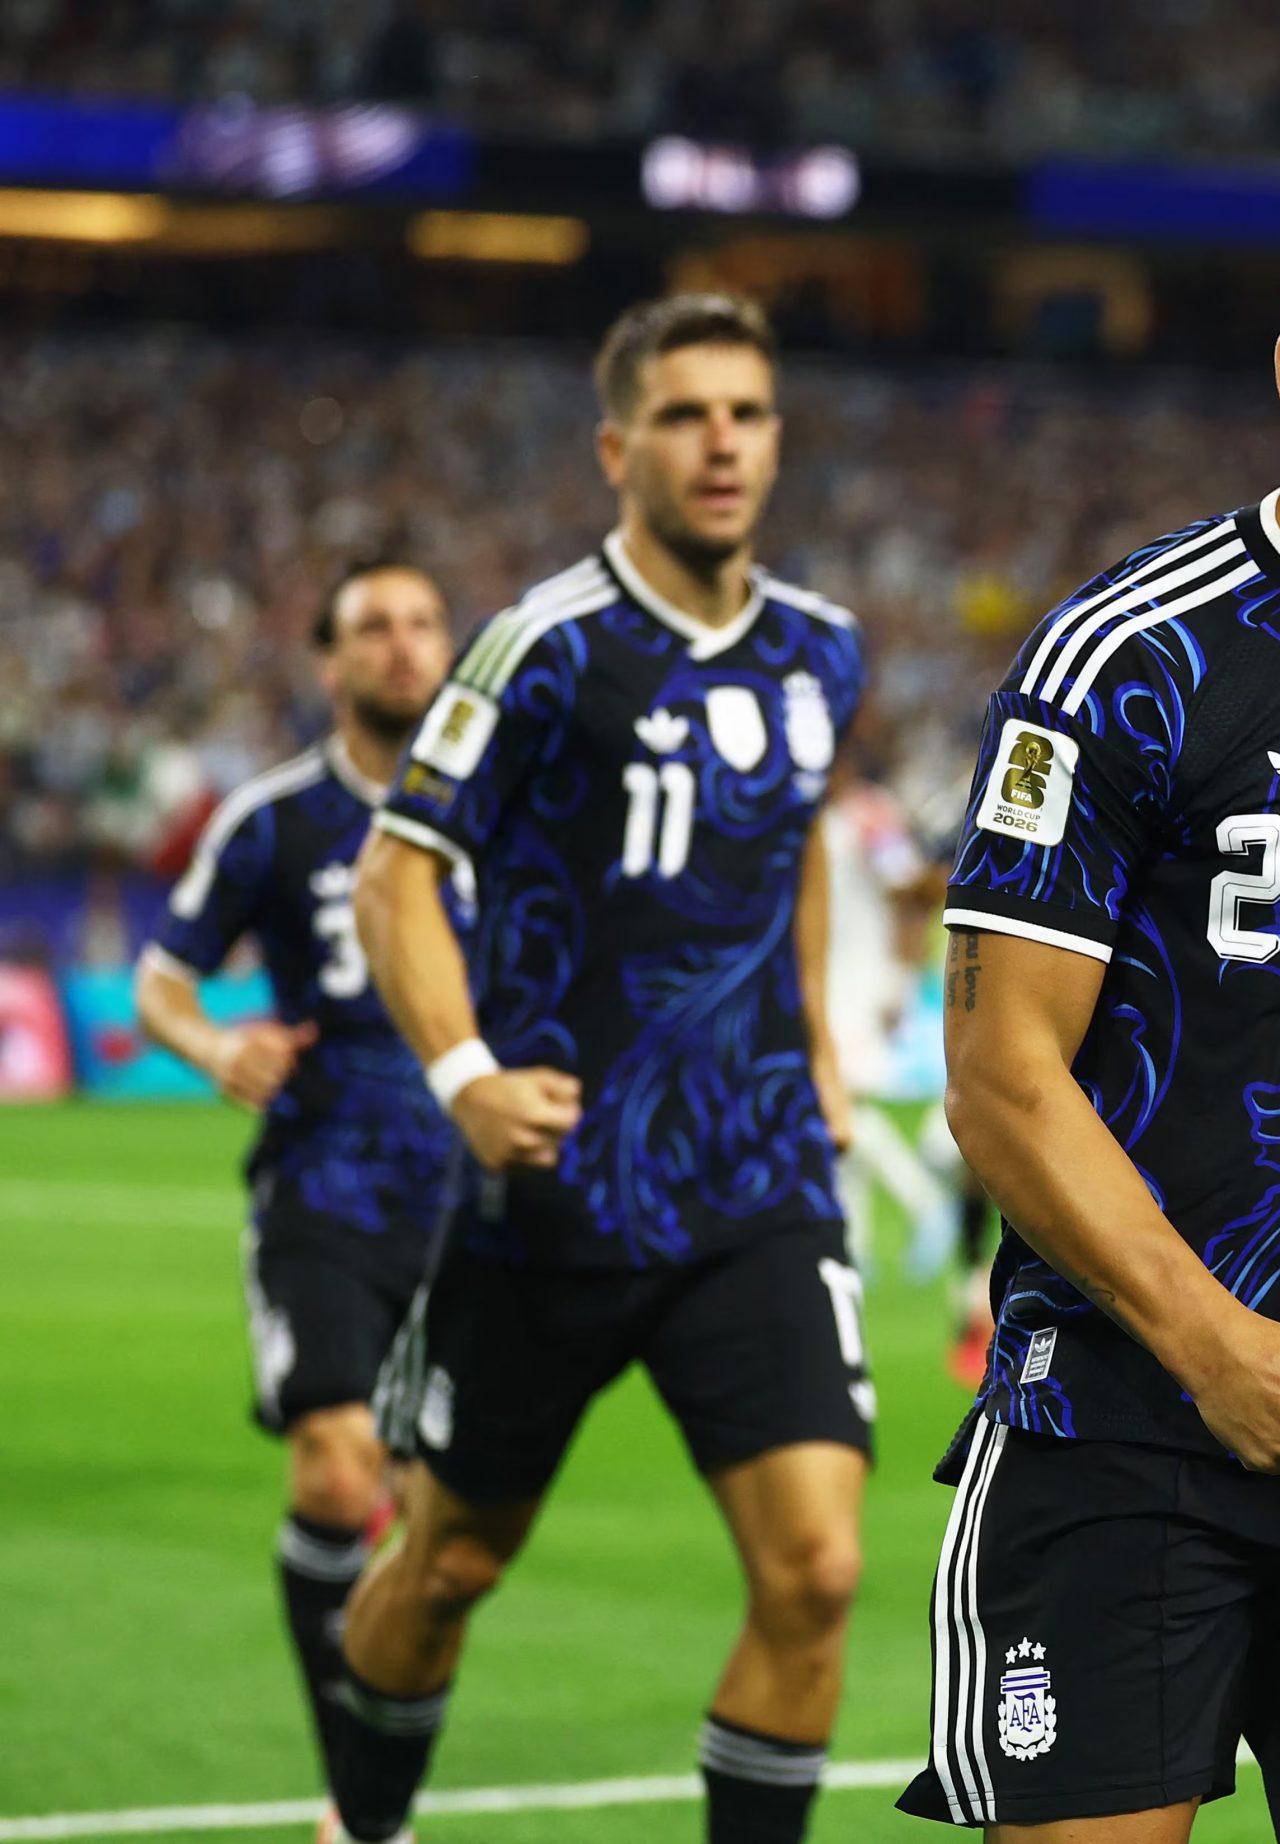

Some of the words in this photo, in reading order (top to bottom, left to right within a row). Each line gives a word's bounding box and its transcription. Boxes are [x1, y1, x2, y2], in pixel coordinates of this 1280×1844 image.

[1011, 788, 1032, 803] FIFA
[622, 762, 695, 879] 11
[993, 812, 1038, 832] 2026
[996, 804, 1023, 816] WORLD
[1024, 811, 1041, 821] CUP
[312, 902, 369, 999] 3
[1009, 1691, 1041, 1733] AFA
